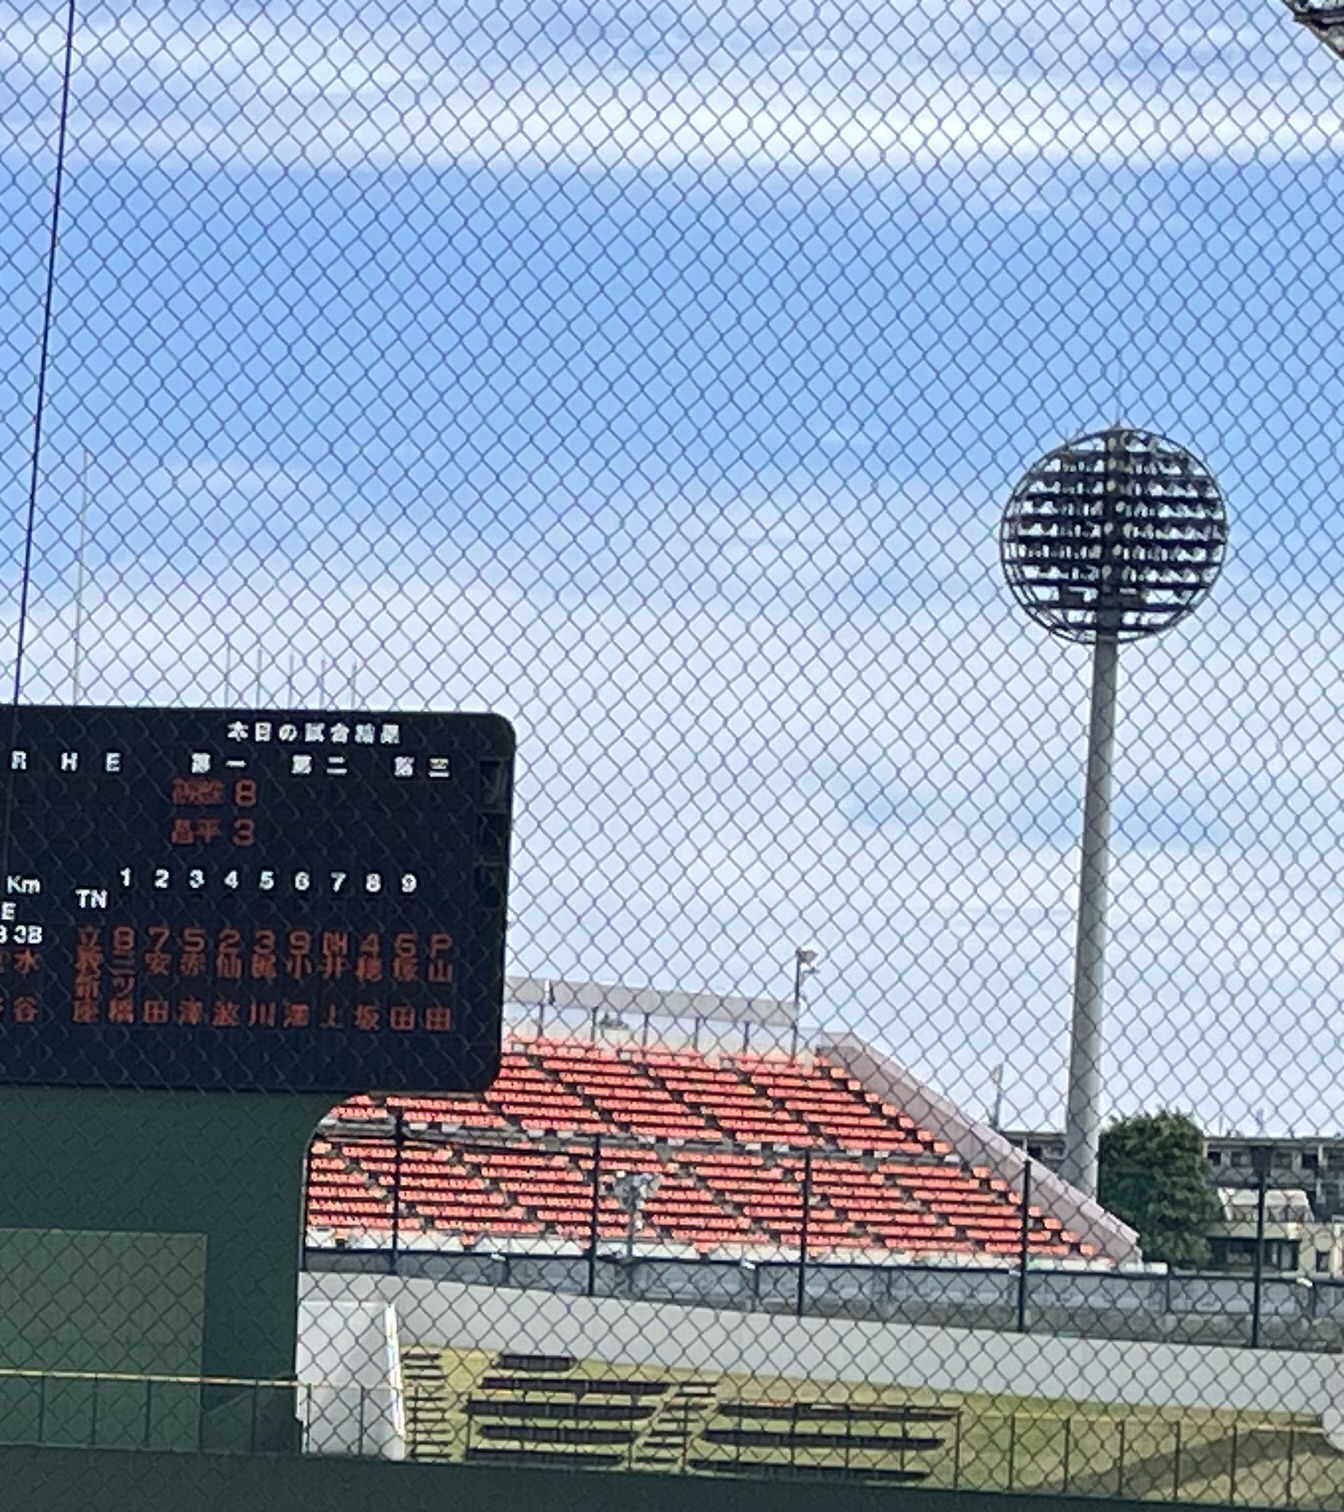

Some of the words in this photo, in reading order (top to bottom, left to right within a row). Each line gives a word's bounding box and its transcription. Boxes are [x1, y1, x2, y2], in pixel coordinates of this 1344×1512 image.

[11, 750, 27, 770] R
[60, 752, 78, 771] H
[106, 752, 120, 772] E
[235, 779, 257, 807] 8
[233, 818, 254, 846] 3
[120, 867, 131, 887] 1
[154, 869, 170, 889] 2
[189, 869, 205, 889] 3
[224, 870, 239, 889] 4
[259, 871, 274, 890] 5
[294, 871, 310, 891] 6
[331, 873, 346, 892] 7
[365, 873, 382, 893] 8
[401, 873, 417, 893] 9
[13, 925, 43, 944] 3B
